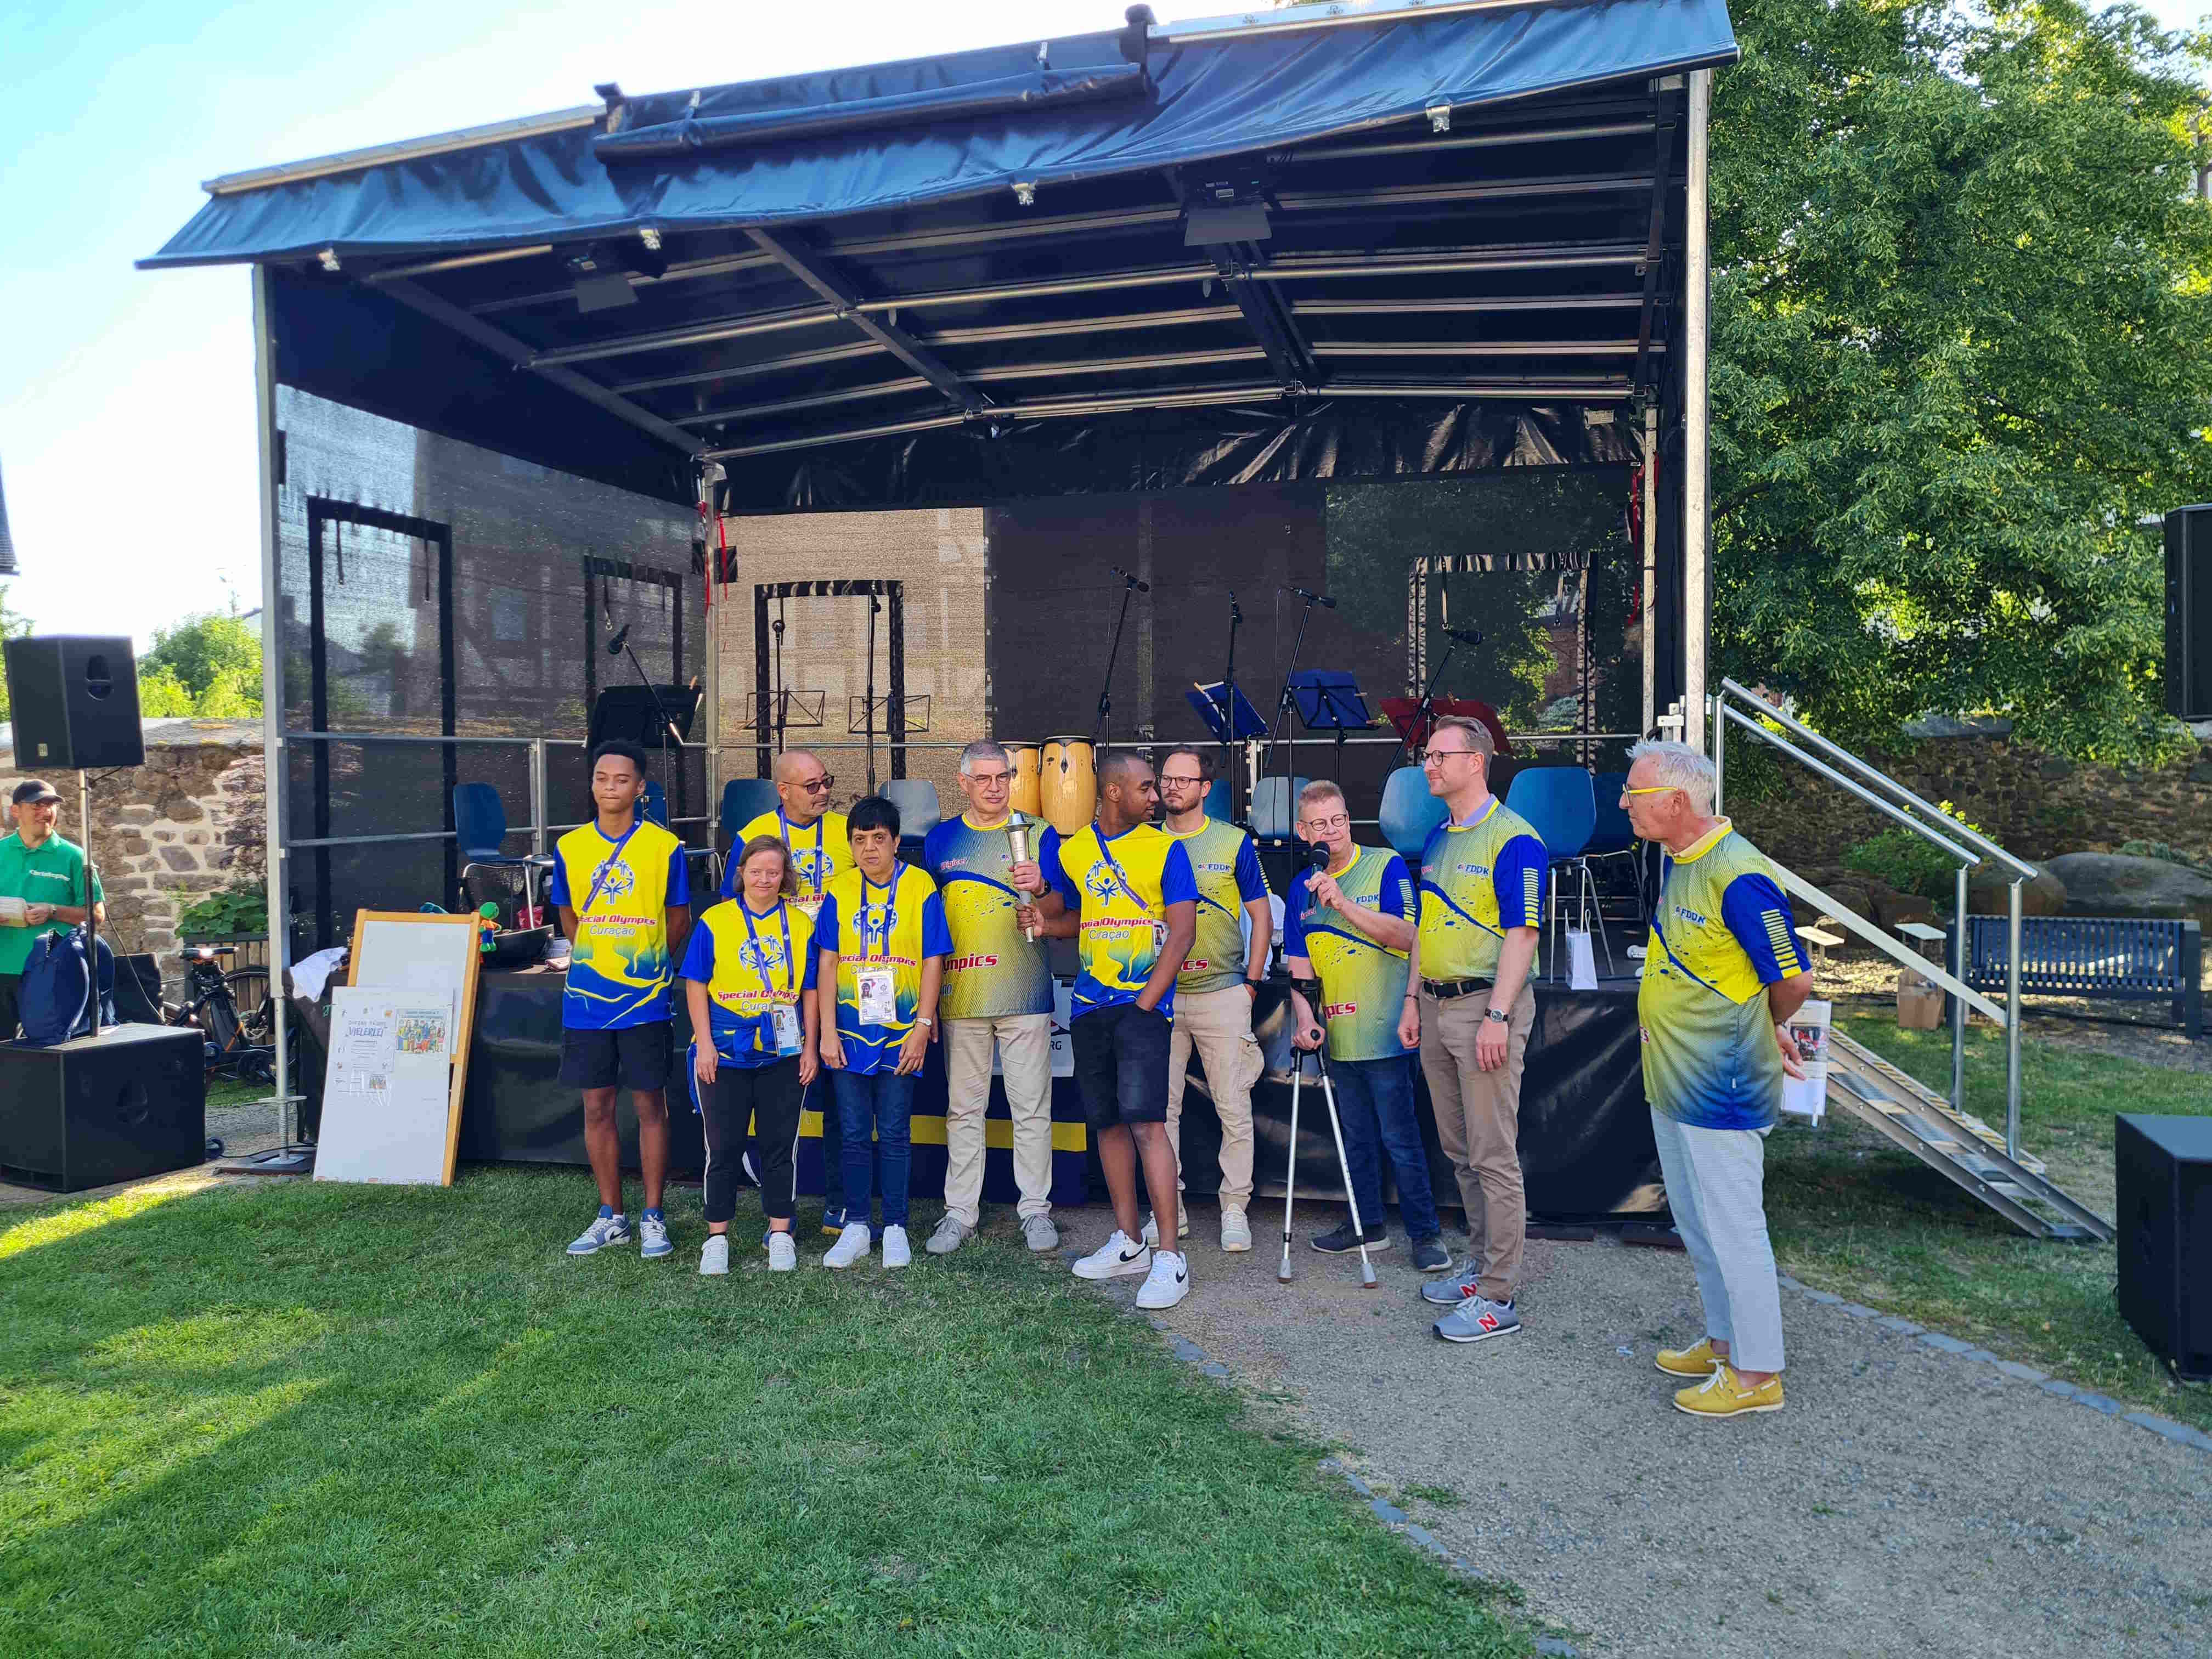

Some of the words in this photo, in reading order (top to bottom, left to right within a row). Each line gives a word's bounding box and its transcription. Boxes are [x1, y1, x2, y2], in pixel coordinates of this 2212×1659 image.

[1465, 865, 1489, 875] FDDK
[1356, 894, 1379, 903] FDDK
[1680, 908, 1706, 924] FDDK
[1089, 929, 1130, 941] Craçao
[943, 953, 998, 974] ympics
[718, 990, 758, 1001] Special
[760, 989, 799, 1001] Olympic
[741, 1000, 769, 1011] Cura
[1477, 1312, 1499, 1332] N
